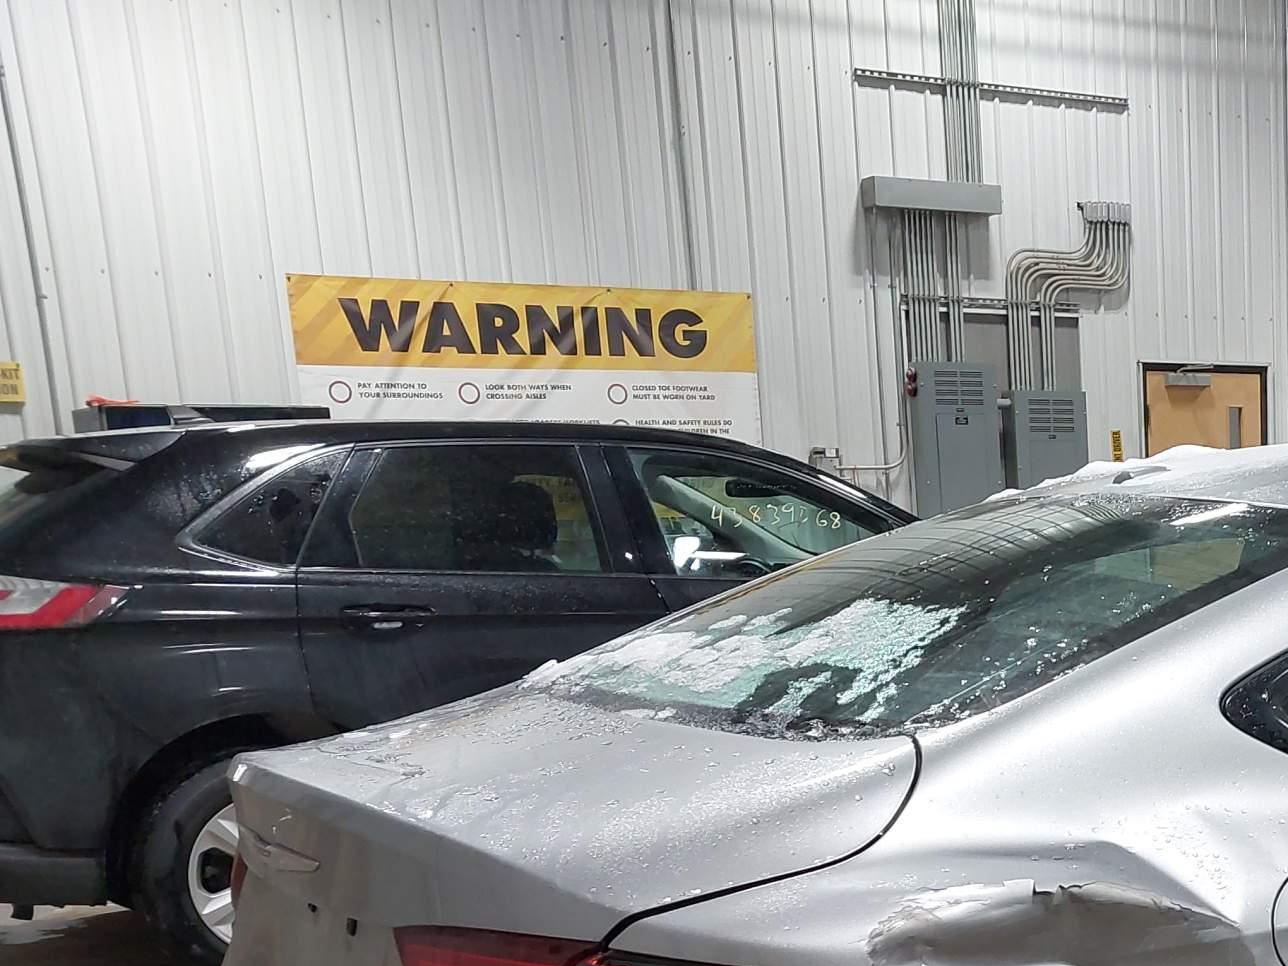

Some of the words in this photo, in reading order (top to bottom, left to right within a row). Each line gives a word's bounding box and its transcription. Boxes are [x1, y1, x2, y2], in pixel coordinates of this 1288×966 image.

[338, 297, 707, 359] WARNING
[375, 382, 415, 390] ATTENTION
[417, 382, 427, 390] TO
[485, 383, 505, 391] LOOK
[658, 384, 671, 392] TOE
[359, 391, 381, 399] YOUR
[382, 391, 444, 399] SURROUNDINGS
[486, 392, 523, 400] CROSSING
[526, 392, 547, 400] AISLES
